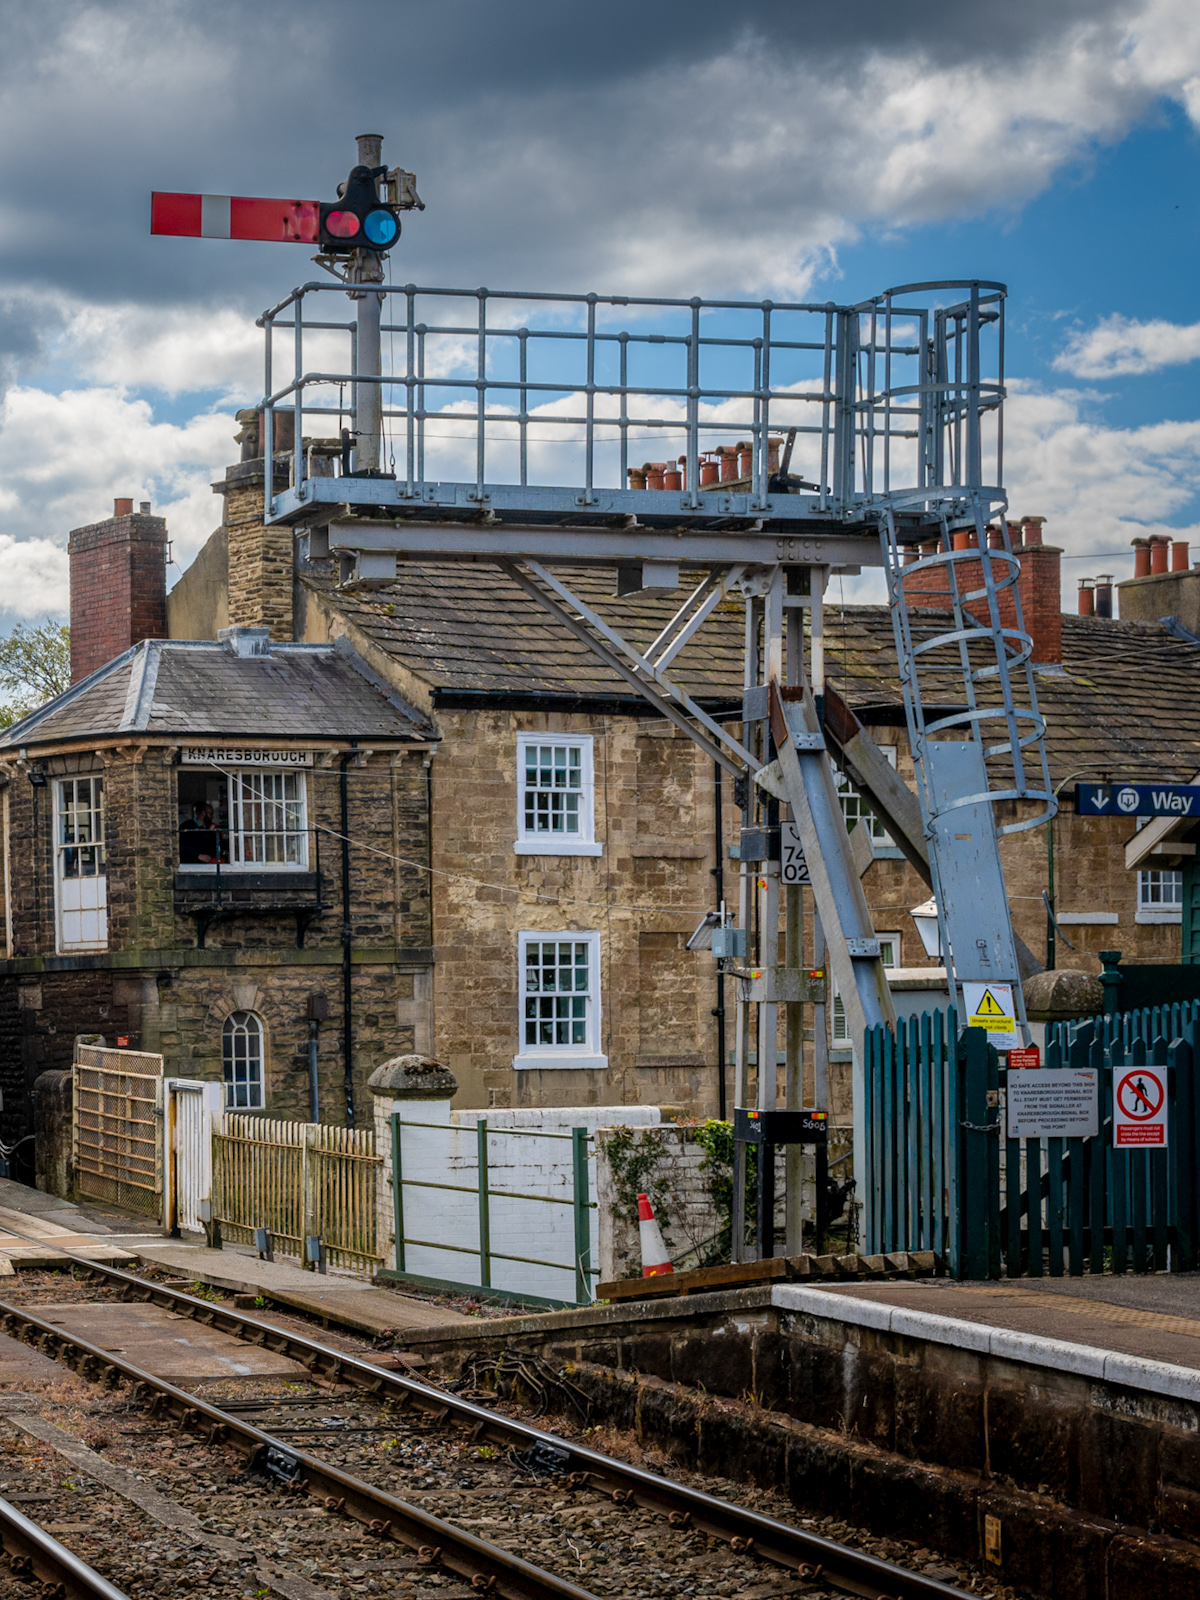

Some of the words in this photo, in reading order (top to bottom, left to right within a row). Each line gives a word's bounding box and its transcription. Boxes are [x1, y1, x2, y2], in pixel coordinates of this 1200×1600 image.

[188, 748, 306, 762] KNARESBOROUGH
[1152, 792, 1193, 815] Way
[784, 846, 806, 863] 74
[784, 864, 810, 881] 02
